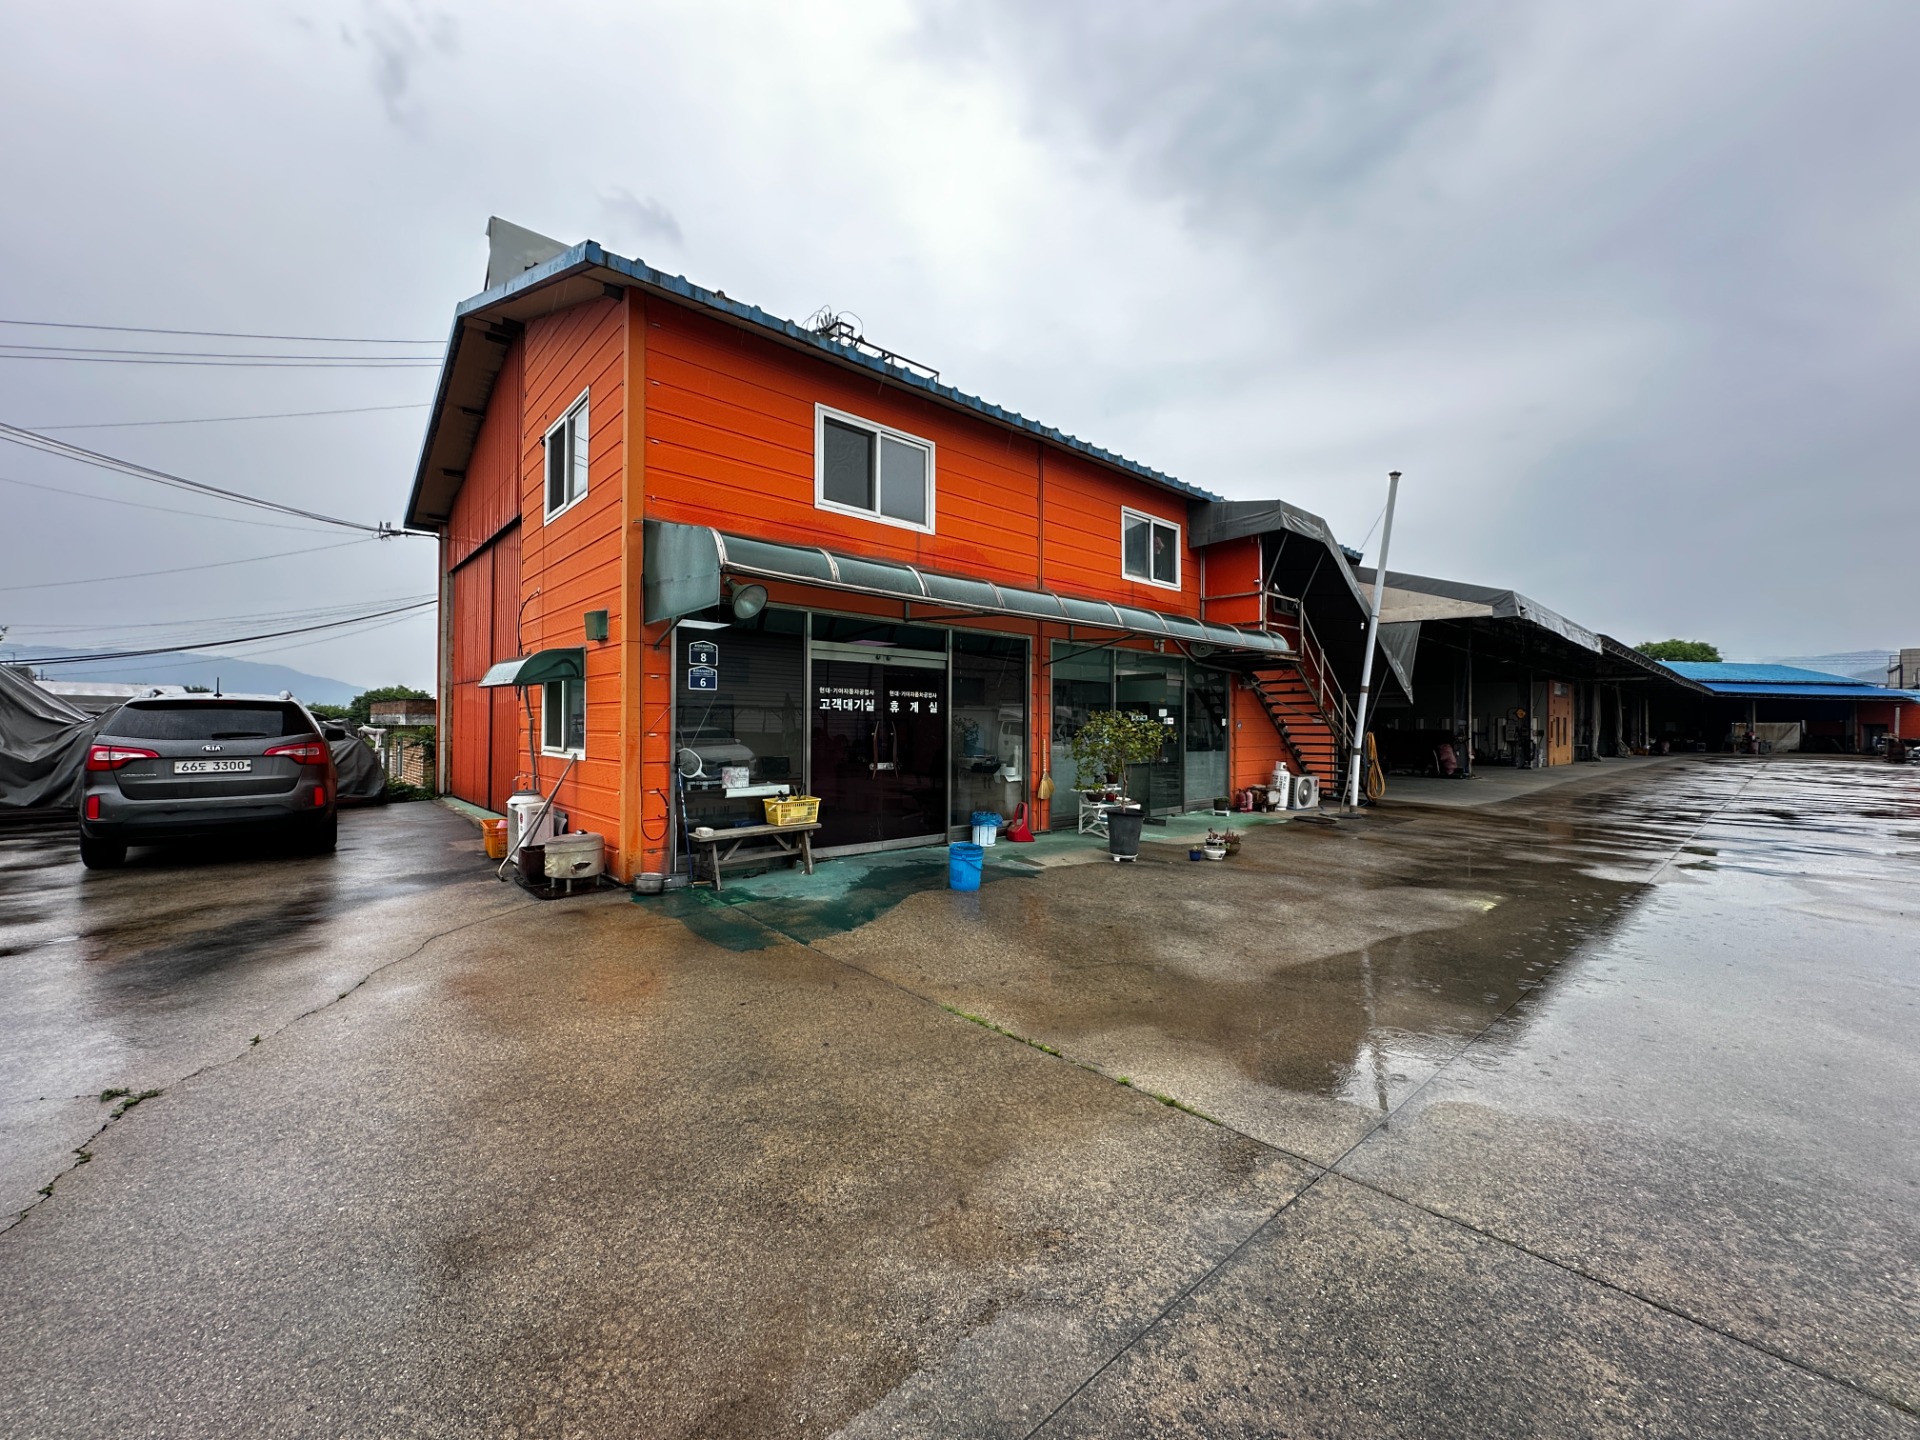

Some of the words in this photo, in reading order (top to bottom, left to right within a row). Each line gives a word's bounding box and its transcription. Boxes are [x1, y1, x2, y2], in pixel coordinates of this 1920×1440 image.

[700, 653, 707, 662] 8
[700, 678, 707, 687] 6
[819, 698, 875, 712] 고객대기실
[204, 744, 222, 752] KIA
[212, 761, 245, 771] 3300
